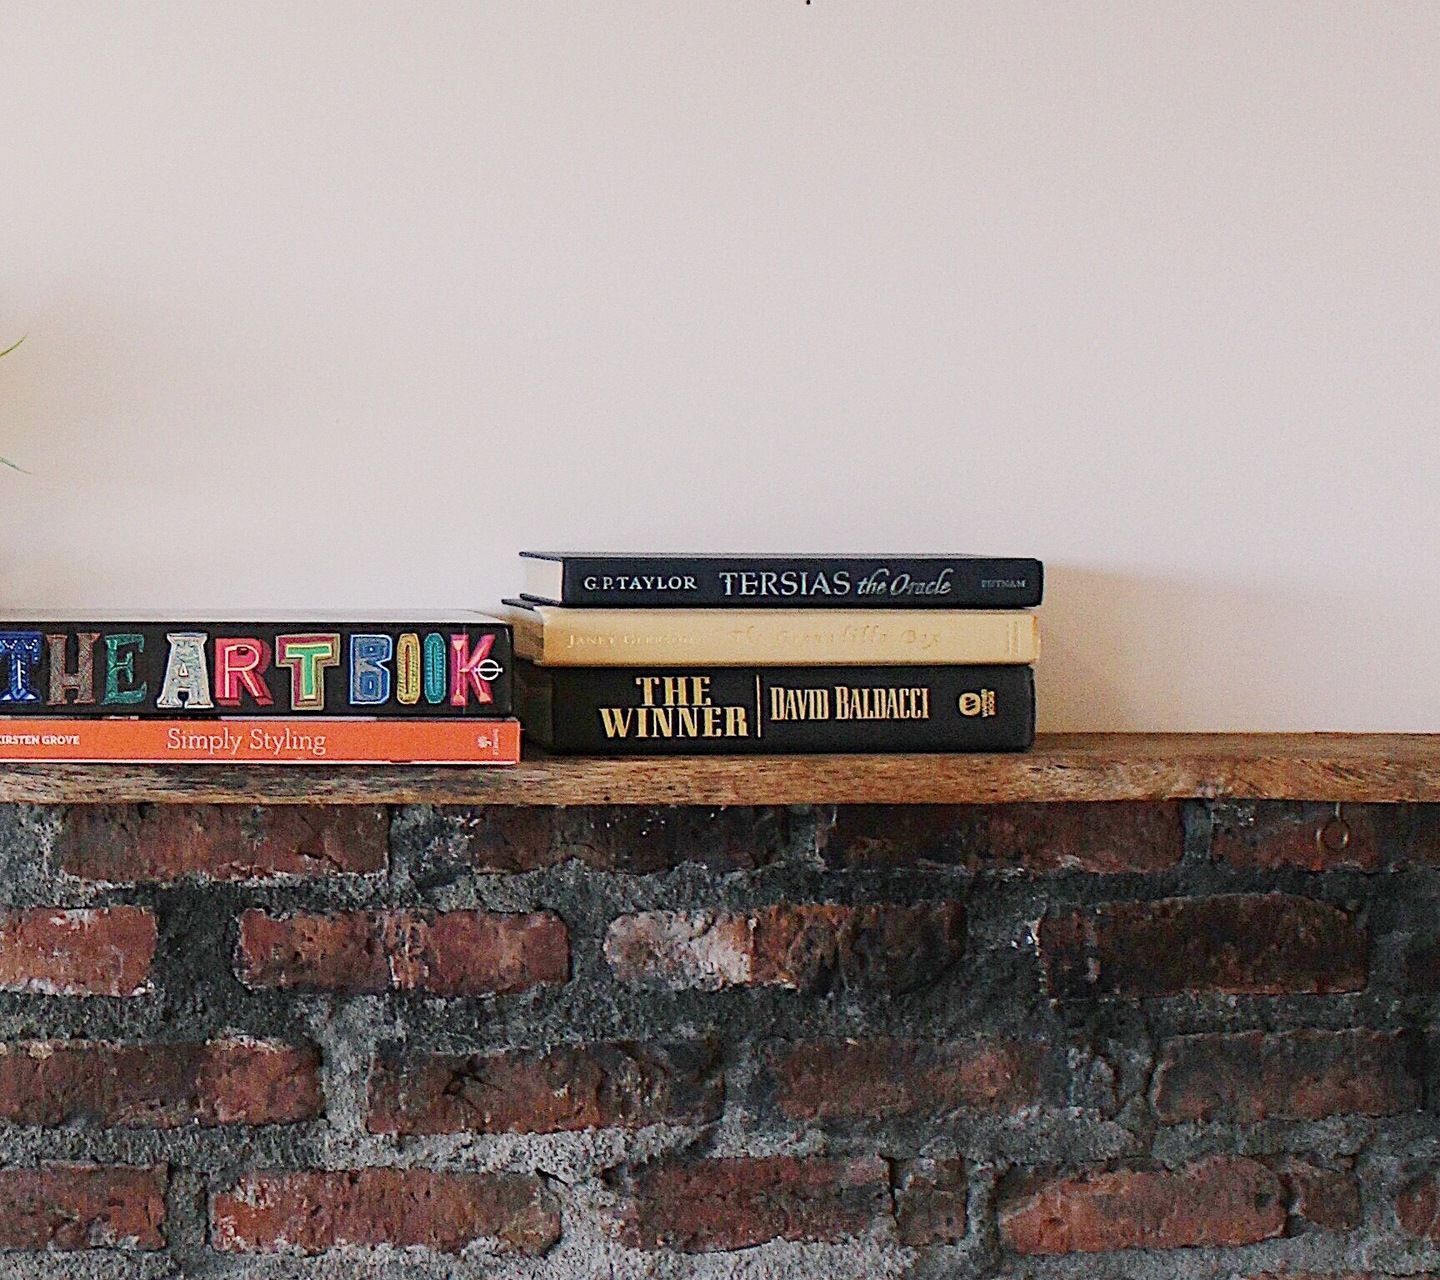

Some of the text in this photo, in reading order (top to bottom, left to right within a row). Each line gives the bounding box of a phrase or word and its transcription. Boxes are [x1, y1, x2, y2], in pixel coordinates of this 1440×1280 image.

[719, 571, 850, 596] TERSIAS
[857, 568, 889, 595] the
[890, 568, 954, 596] Oracle
[157, 632, 341, 710] ART
[349, 632, 496, 707] BOOK
[635, 676, 712, 707] THE
[770, 686, 930, 720] DAVID BALDACCI
[598, 706, 749, 738] WINNER
[41, 735, 80, 745] GROVE
[167, 727, 327, 756] Simply Styling
